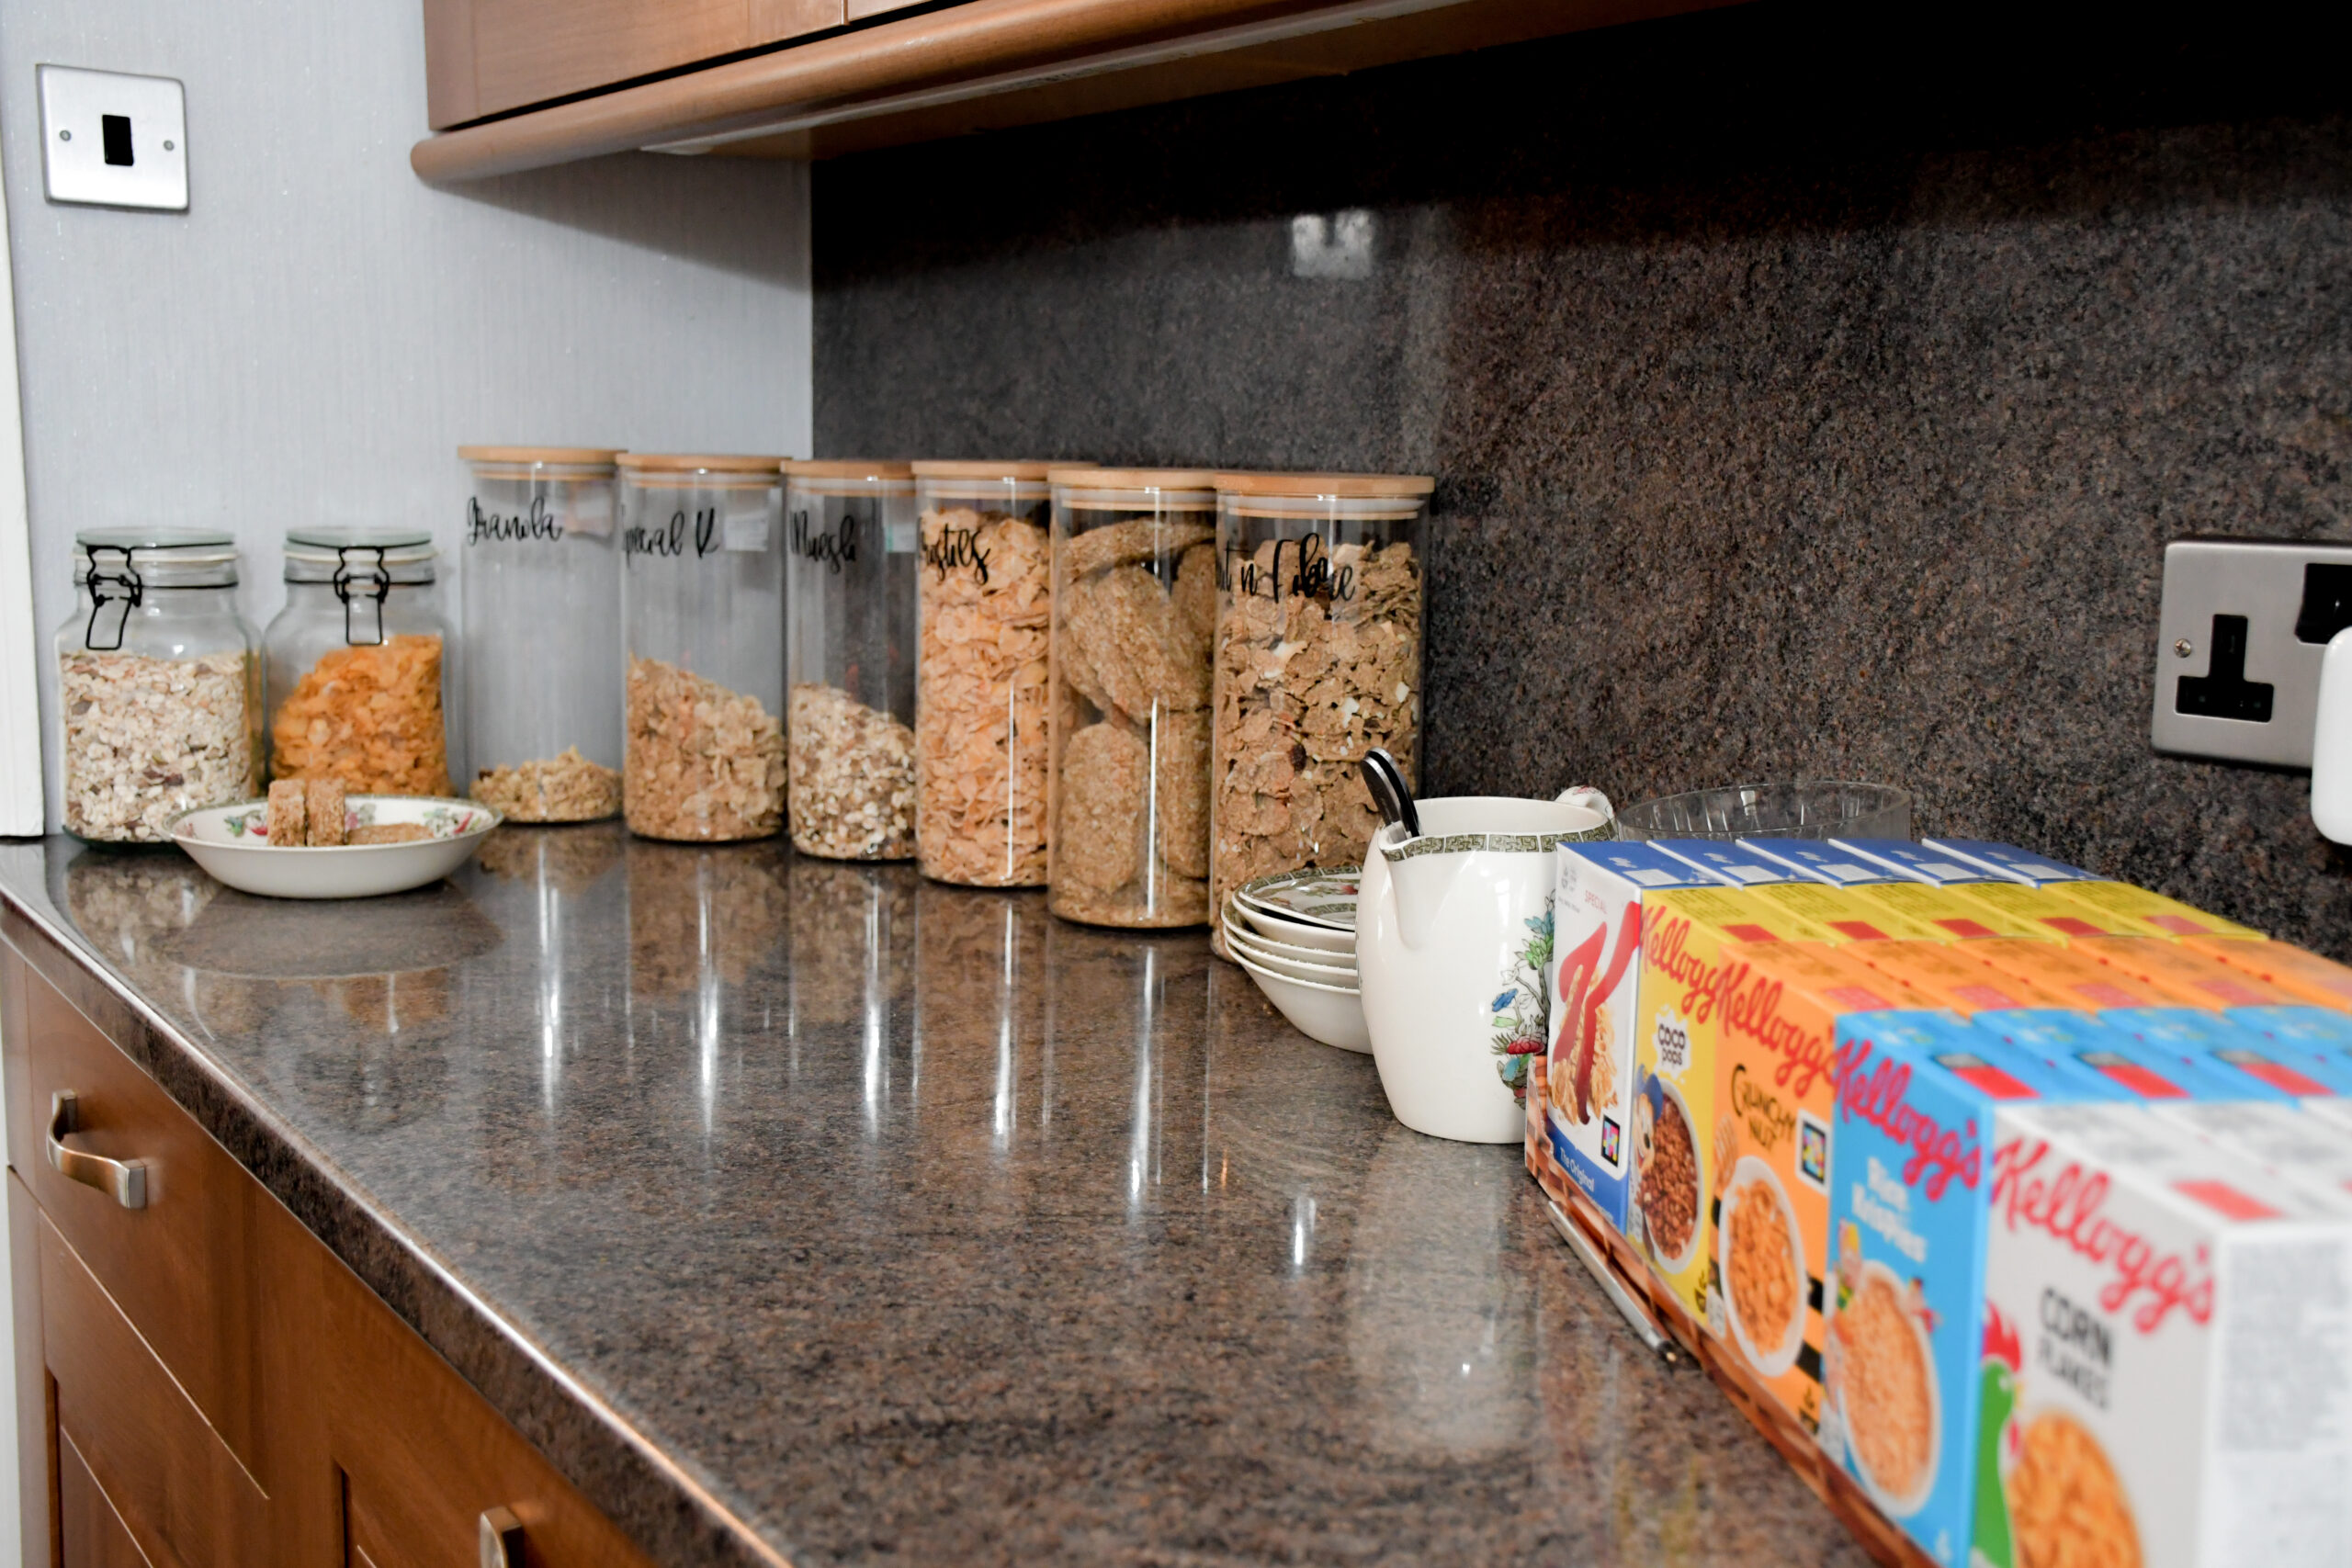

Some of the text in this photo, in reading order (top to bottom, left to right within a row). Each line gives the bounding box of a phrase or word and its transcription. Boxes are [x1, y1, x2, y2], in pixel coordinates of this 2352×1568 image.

[467, 496, 563, 547] Granola
[695, 507, 721, 560] K
[1240, 562, 1259, 597] n
[1584, 888, 1609, 915] SPECIAL
[1552, 900, 1641, 1125] K
[1748, 1116, 1778, 1153] NUT
[1832, 1038, 1982, 1203] Kellogg's
[1559, 1145, 1595, 1192] The Original
[1991, 1136, 2214, 1336] Kellogg's
[2040, 1286, 2112, 1368] CORN
